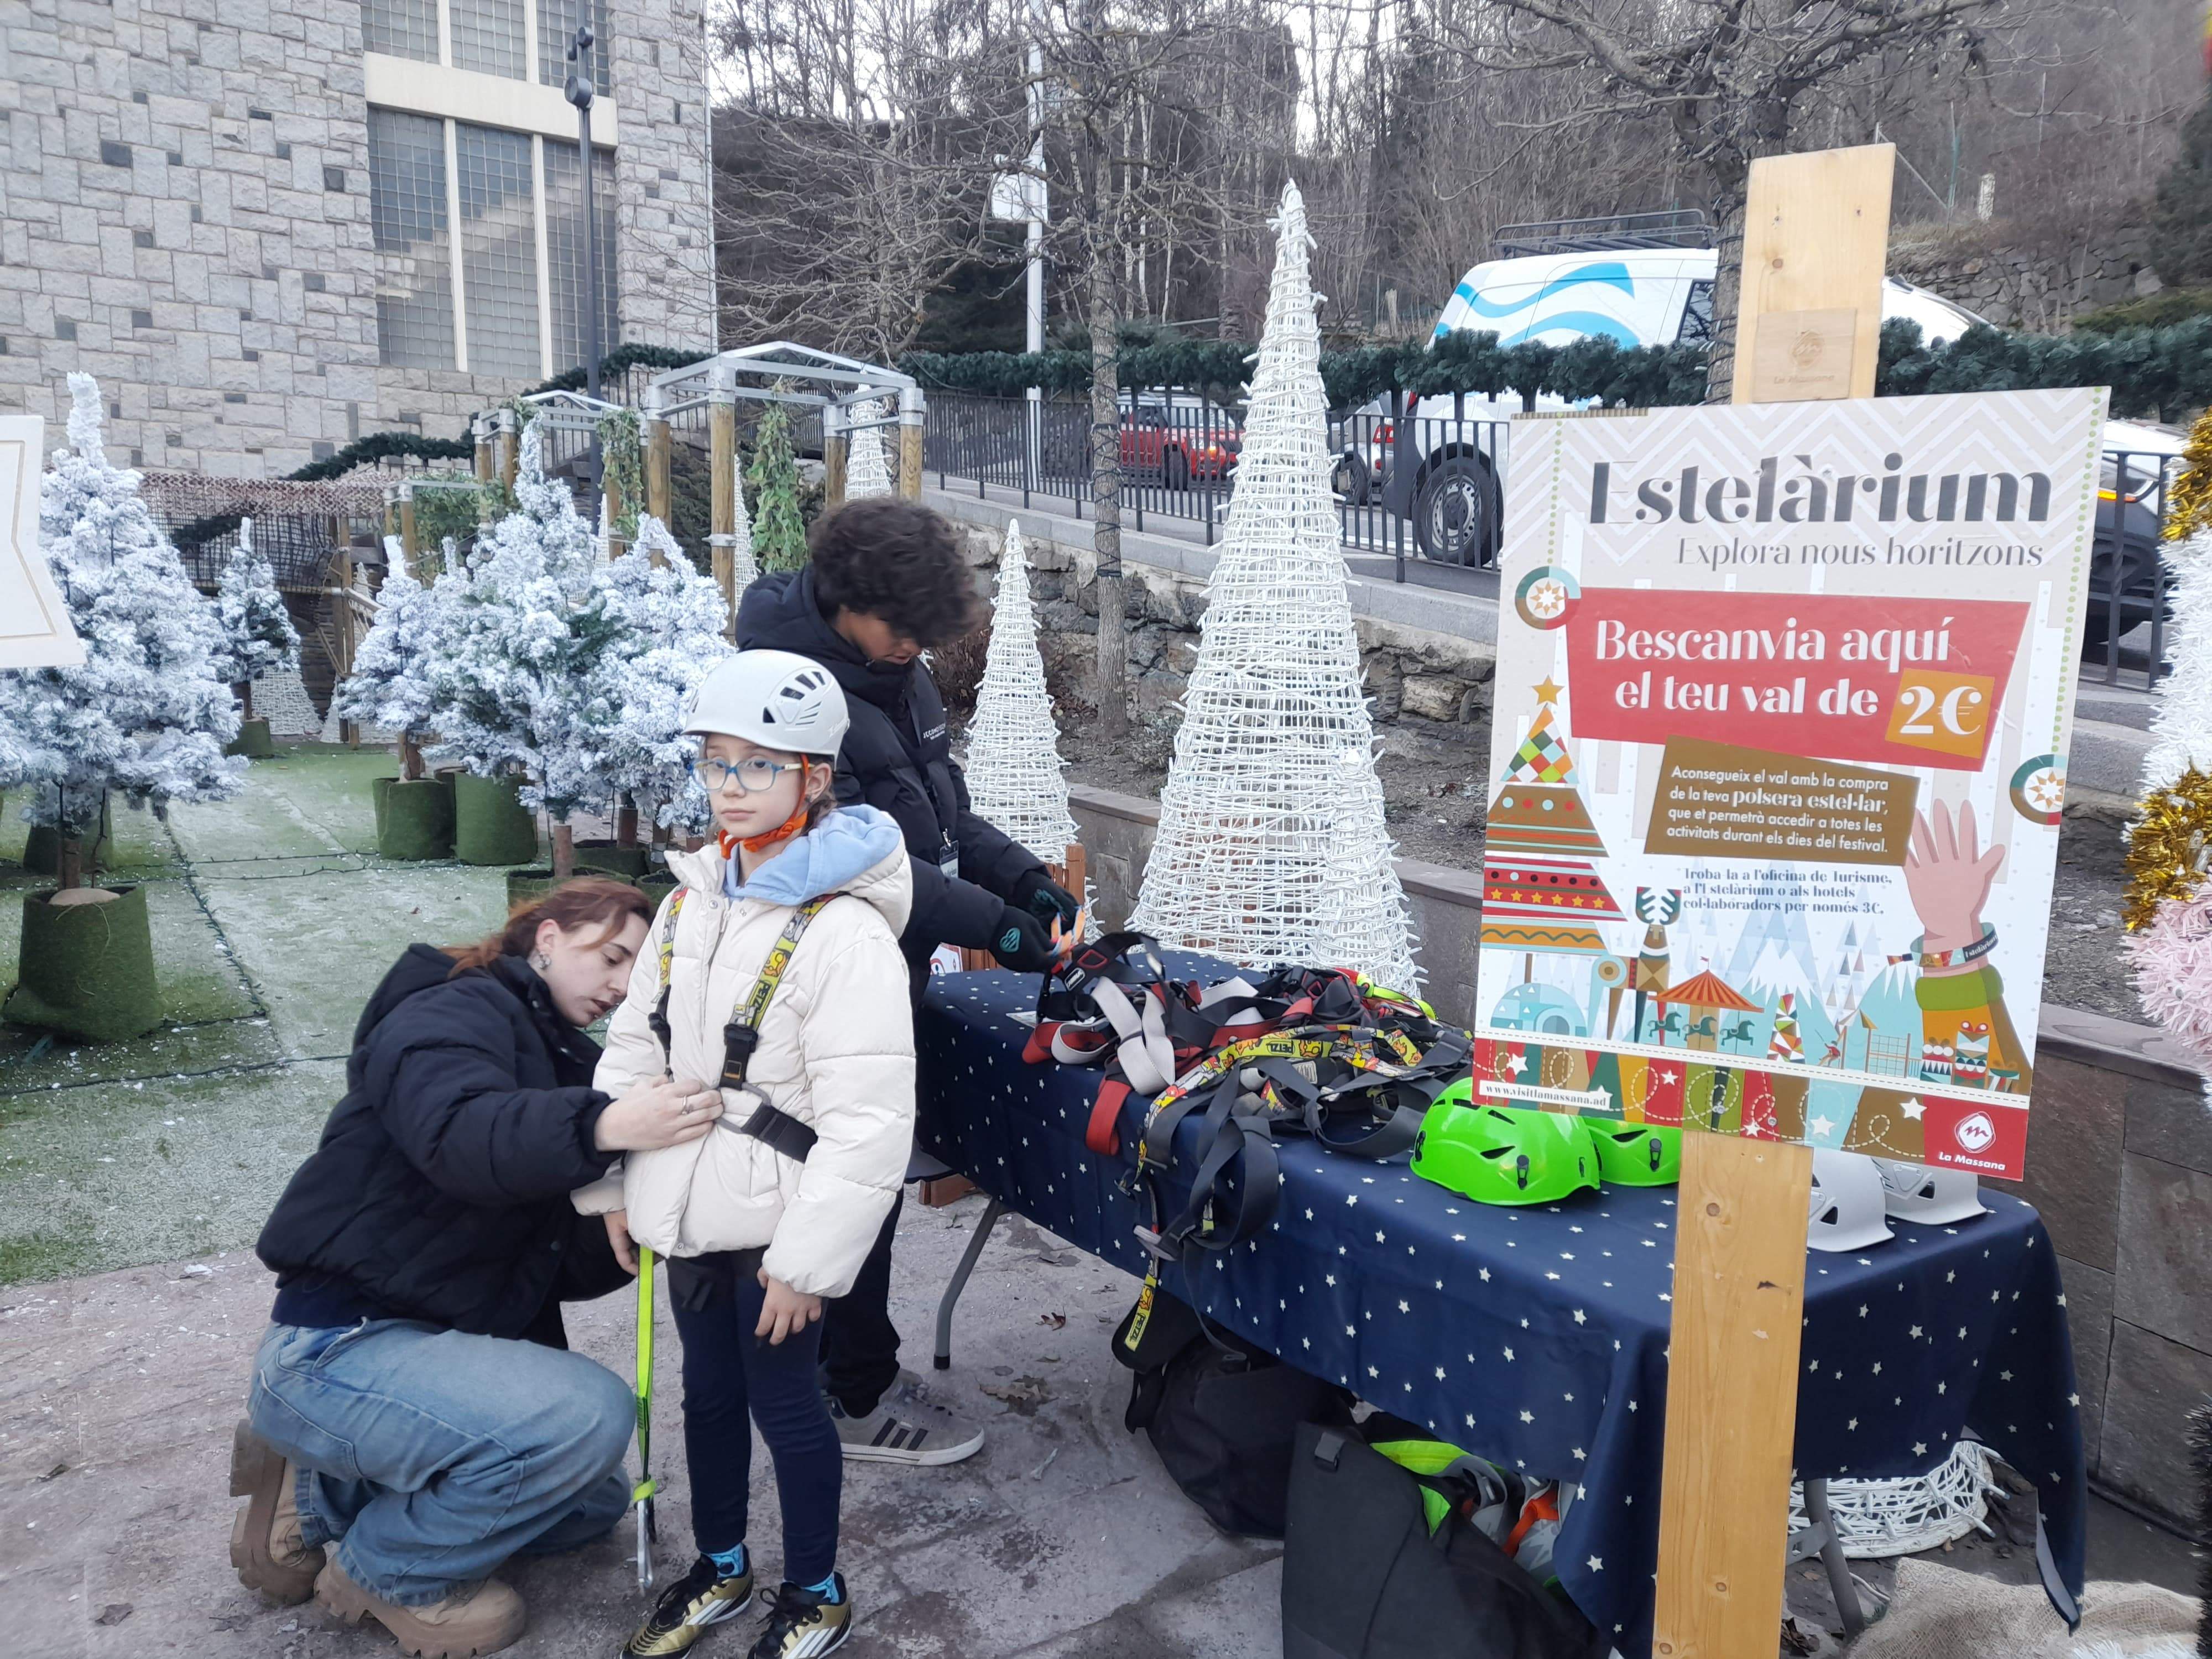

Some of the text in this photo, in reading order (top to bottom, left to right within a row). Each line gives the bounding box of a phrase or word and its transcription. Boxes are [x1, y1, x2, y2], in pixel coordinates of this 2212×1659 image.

[1589, 452, 2052, 524] Estelàrium
[1678, 536, 2043, 571] Explora nous horitzons
[1597, 616, 1955, 672] Bescanvia aquí
[1615, 670, 1982, 736] el teu val de 2€
[1671, 765, 1889, 794] Aconsegueix el val amb la compra
[1670, 785, 1686, 800] de
[1688, 785, 1700, 800] la
[1703, 789, 1730, 802] teva
[1732, 787, 1803, 807] polsera
[1668, 807, 1883, 832] que et permetrà accedir a totes les
[1666, 825, 1888, 853] activitats durant els dies del festival.
[1742, 872, 1750, 880] a
[1754, 869, 1807, 881] l'oficina
[1811, 870, 1828, 882] de
[1683, 885, 1691, 894] a
[1777, 887, 1786, 896] o
[1790, 884, 1809, 897] als
[1813, 885, 1856, 898] hotels
[1785, 902, 1809, 914] per
[1813, 900, 1859, 913] només
[1485, 1085, 1607, 1107] www.visitlamassana.ad
[1938, 1151, 2006, 1171] La Massana
